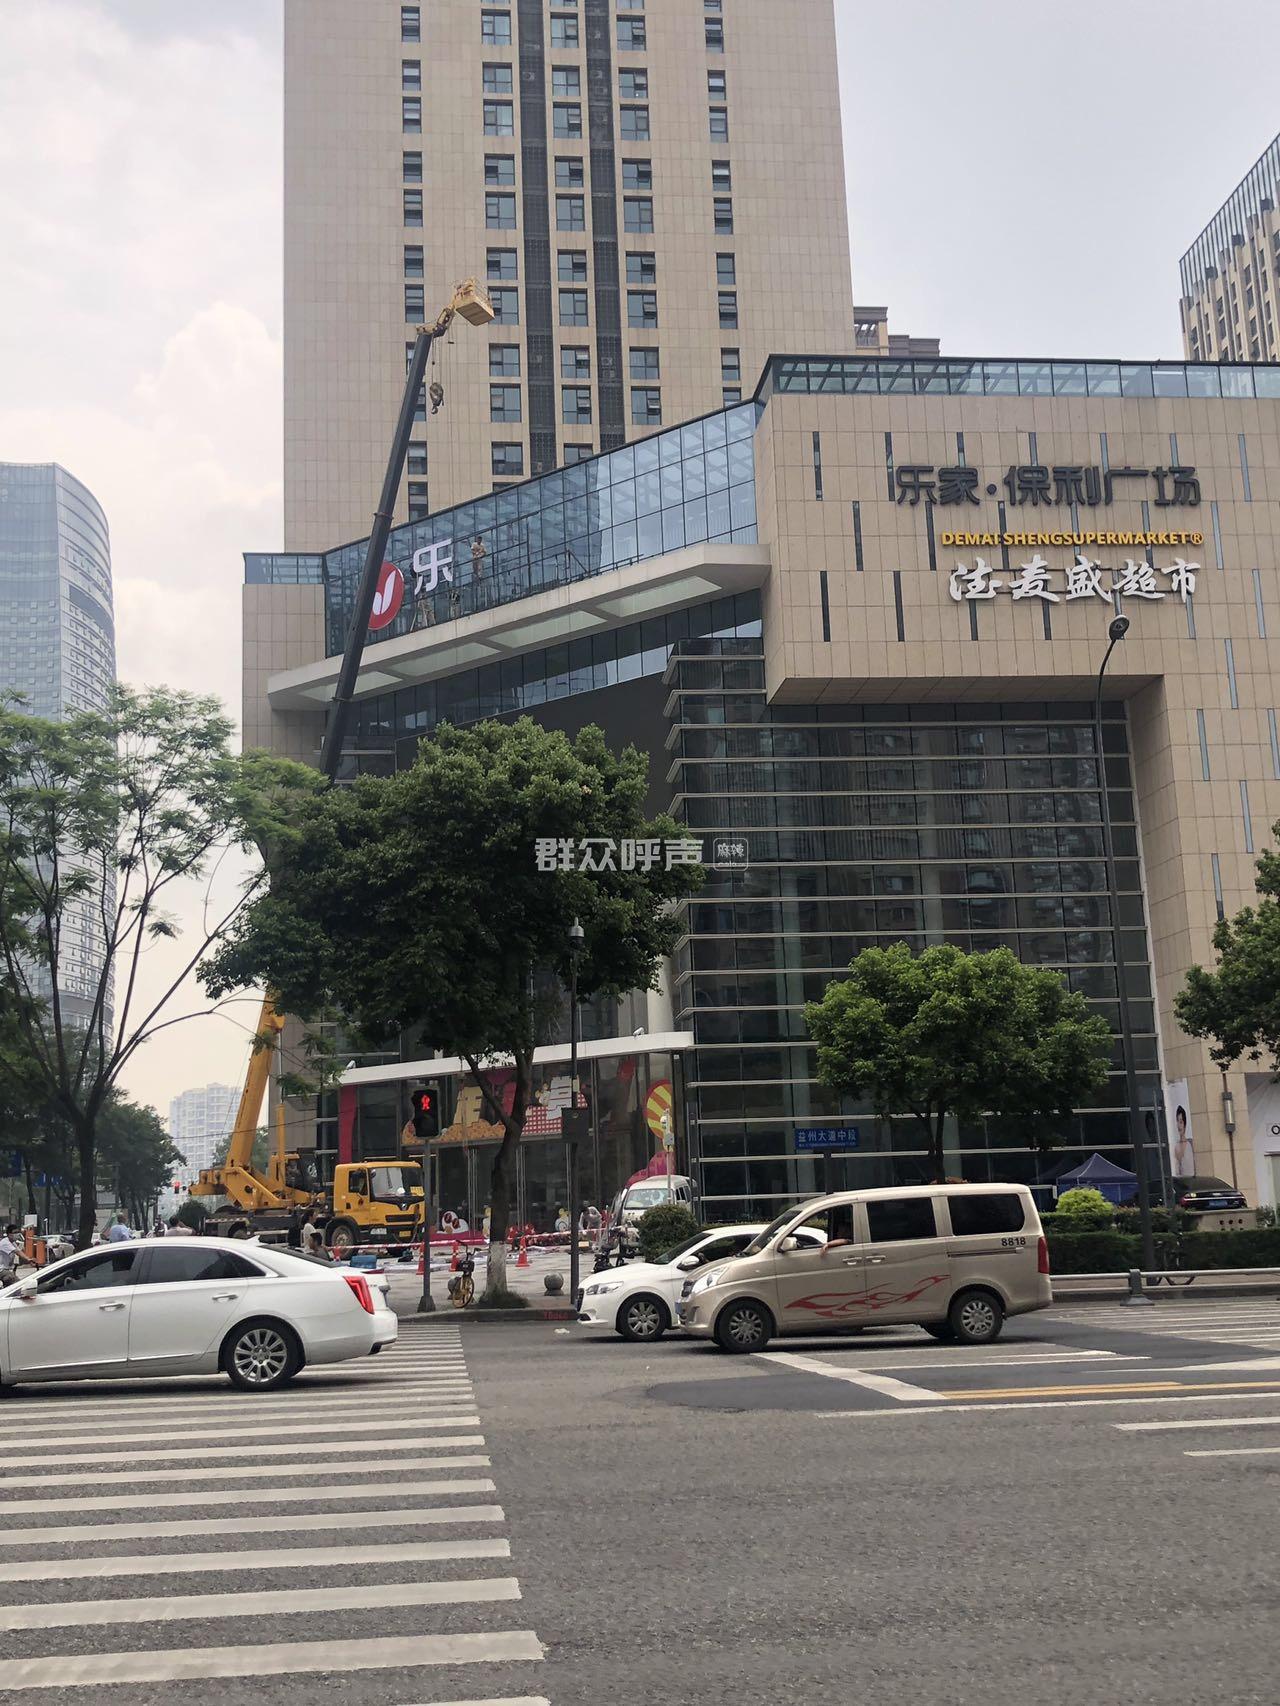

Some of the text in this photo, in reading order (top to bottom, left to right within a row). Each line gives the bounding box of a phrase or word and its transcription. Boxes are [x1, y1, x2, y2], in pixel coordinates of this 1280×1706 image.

[895, 465, 1202, 506] 乐家·保利广场
[1001, 1237, 1026, 1246] 8818
